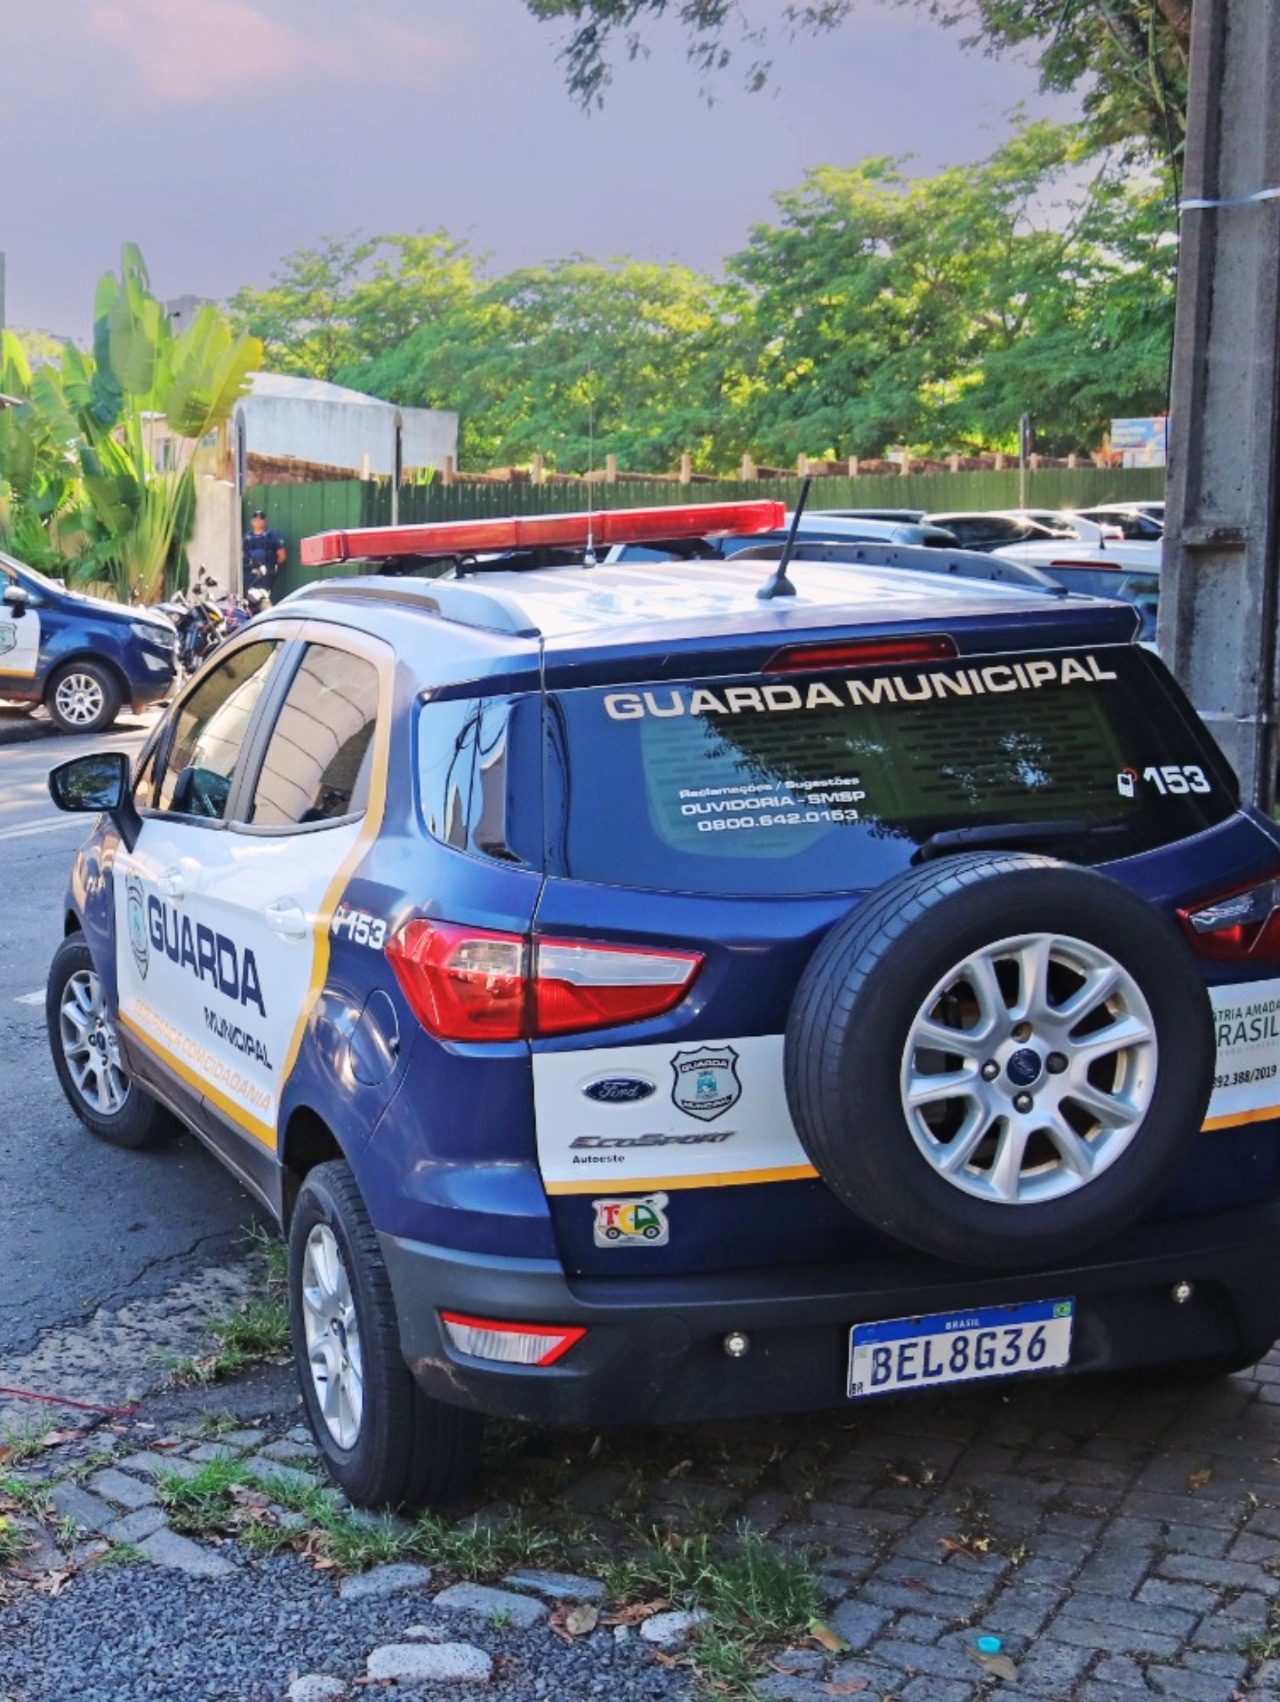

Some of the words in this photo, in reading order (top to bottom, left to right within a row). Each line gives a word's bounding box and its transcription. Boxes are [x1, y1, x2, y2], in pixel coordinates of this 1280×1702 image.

[604, 682, 845, 721] GUARDA
[846, 655, 1118, 707] MUNICIPAL
[785, 776, 860, 790] Sugestões
[1143, 765, 1211, 795] 153
[681, 796, 795, 816] OUVIDORIA
[807, 790, 866, 805] SMSP
[697, 809, 859, 832] 0800.642.0153
[347, 909, 387, 951] 153
[148, 894, 267, 1018] GUARDA
[203, 1006, 272, 1071] MUNICIPAL
[1217, 1015, 1280, 1047] RASIL
[204, 1054, 272, 1113] CIDADANIA
[598, 1081, 640, 1099] Ford
[572, 1154, 625, 1165] Autoeste
[945, 1318, 981, 1331] BRASIL
[870, 1325, 1047, 1387] BEL8G36
